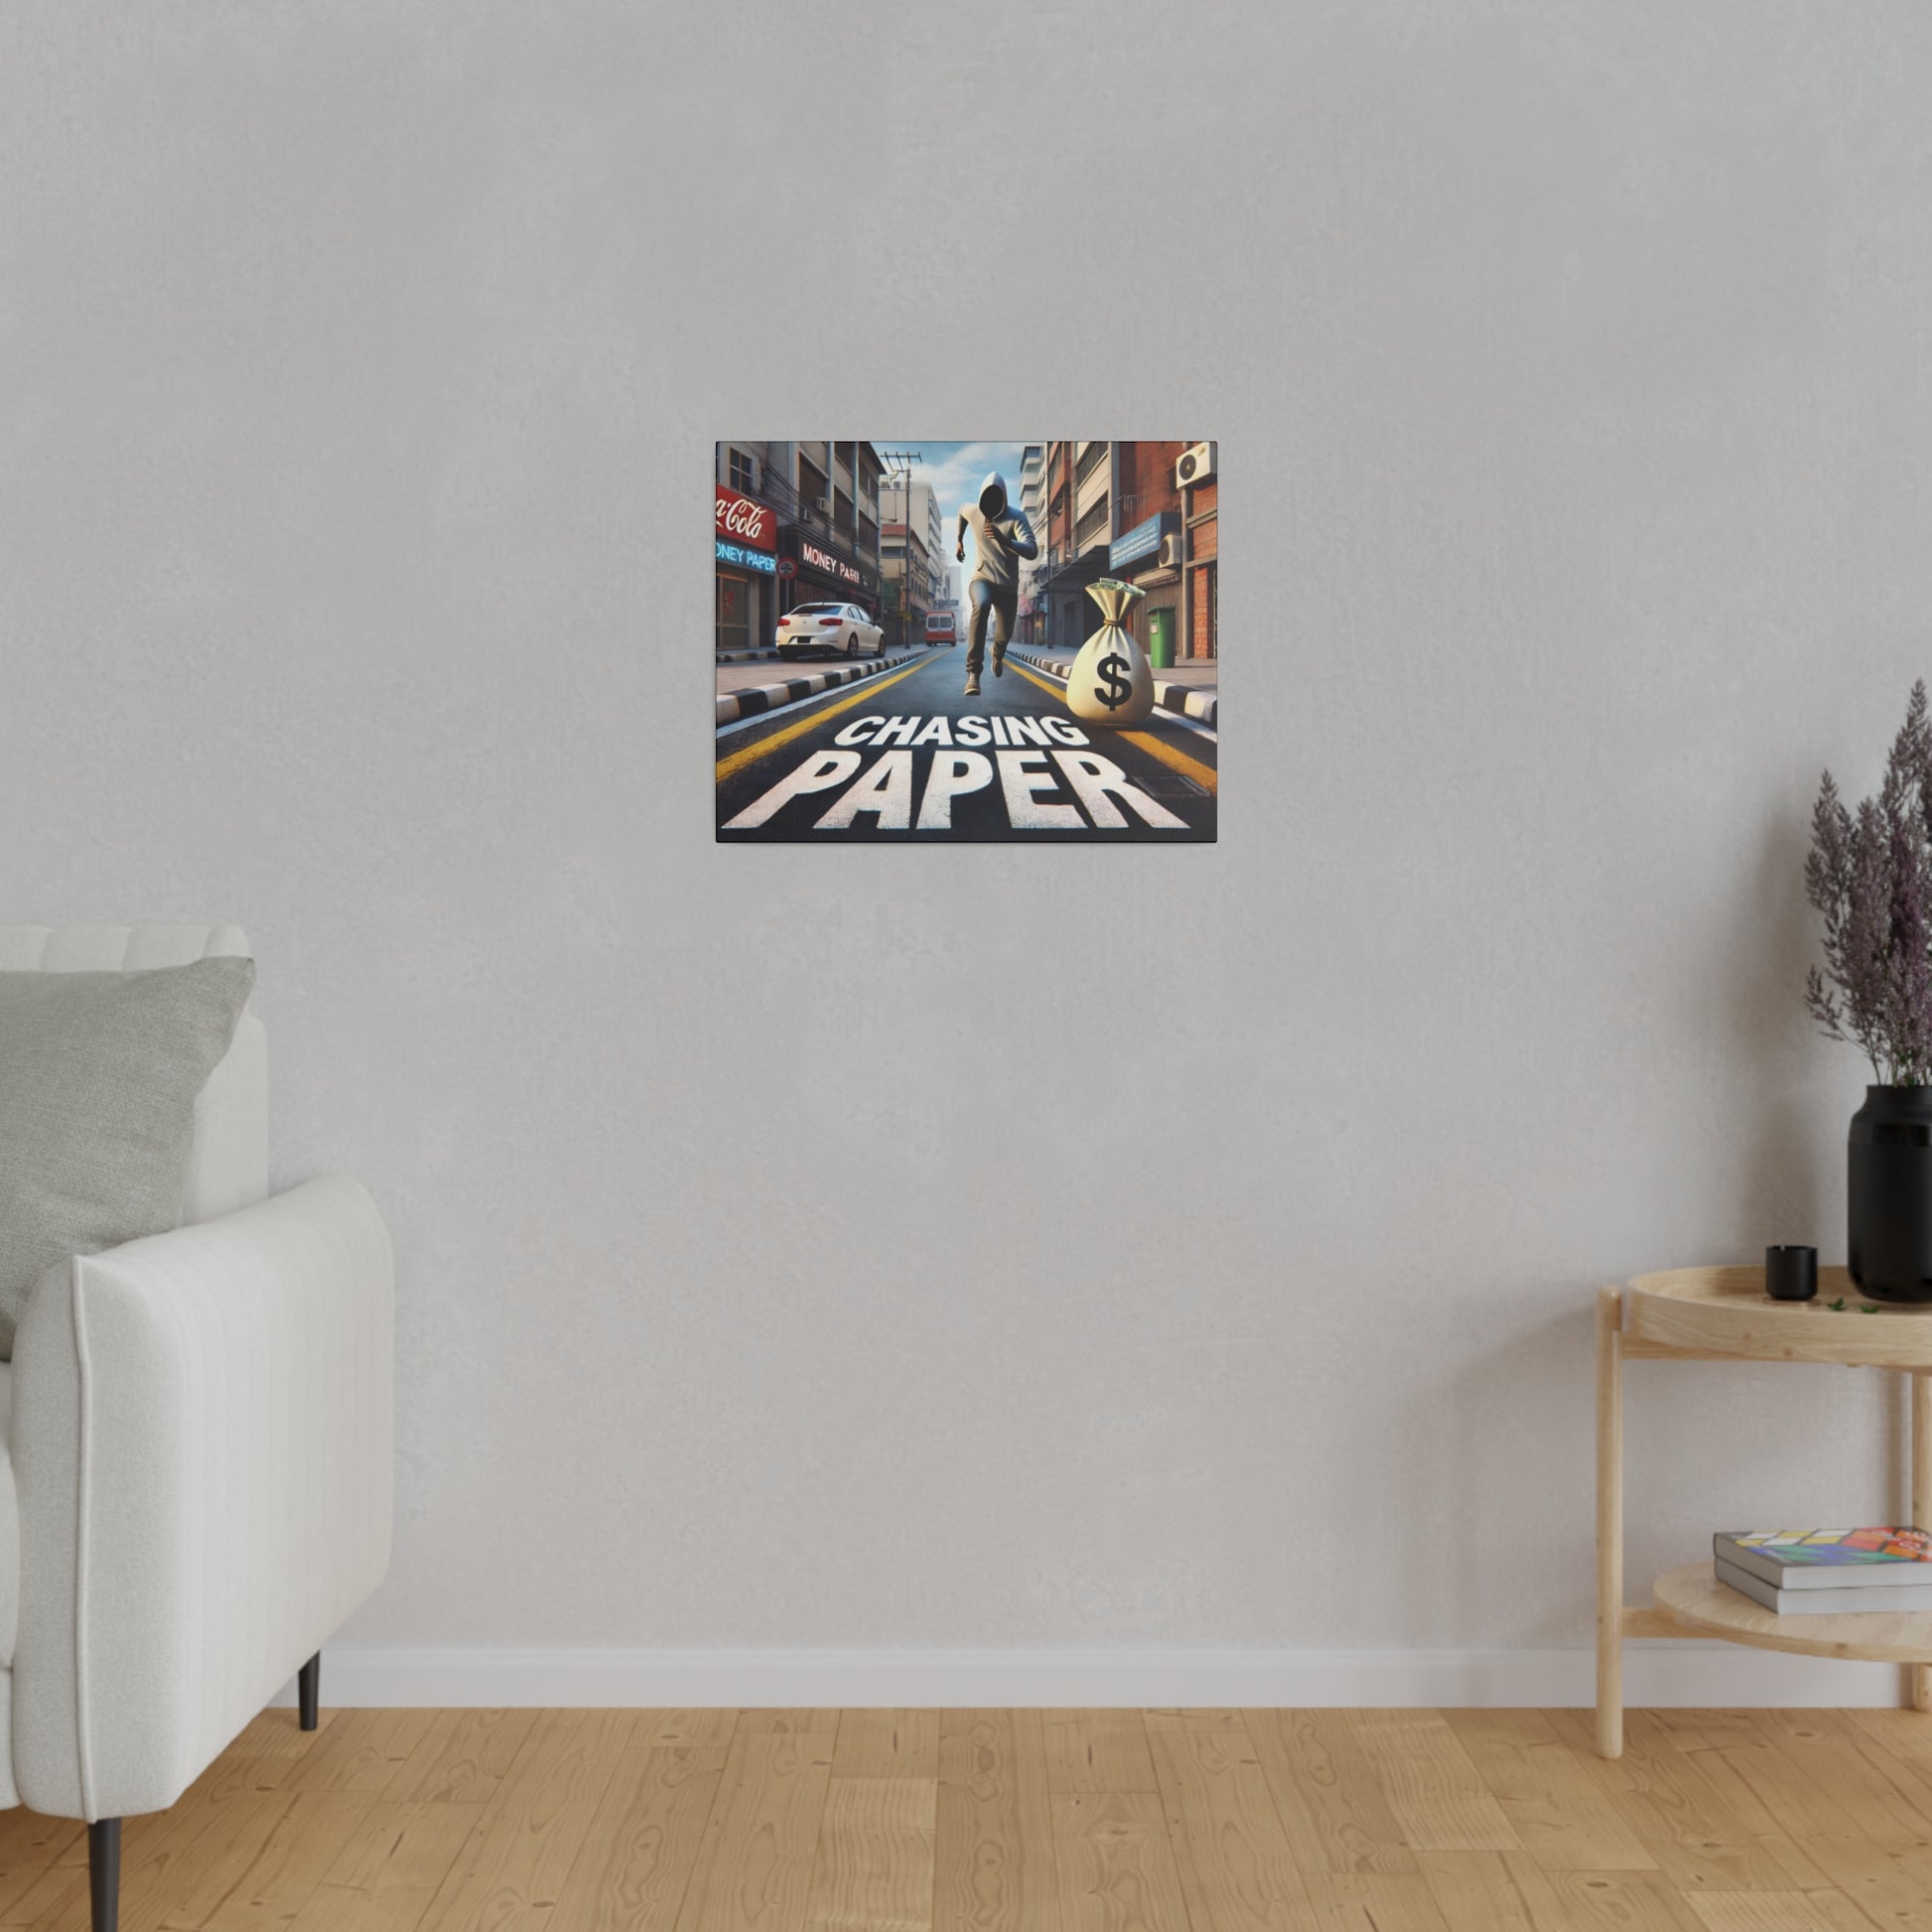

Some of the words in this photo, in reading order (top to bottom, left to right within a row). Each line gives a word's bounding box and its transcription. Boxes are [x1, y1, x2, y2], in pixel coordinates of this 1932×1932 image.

[747, 551, 776, 573] PAPER
[803, 543, 837, 573] MONEY
[834, 715, 1090, 746] CHASING
[721, 750, 1190, 829] PAPER
